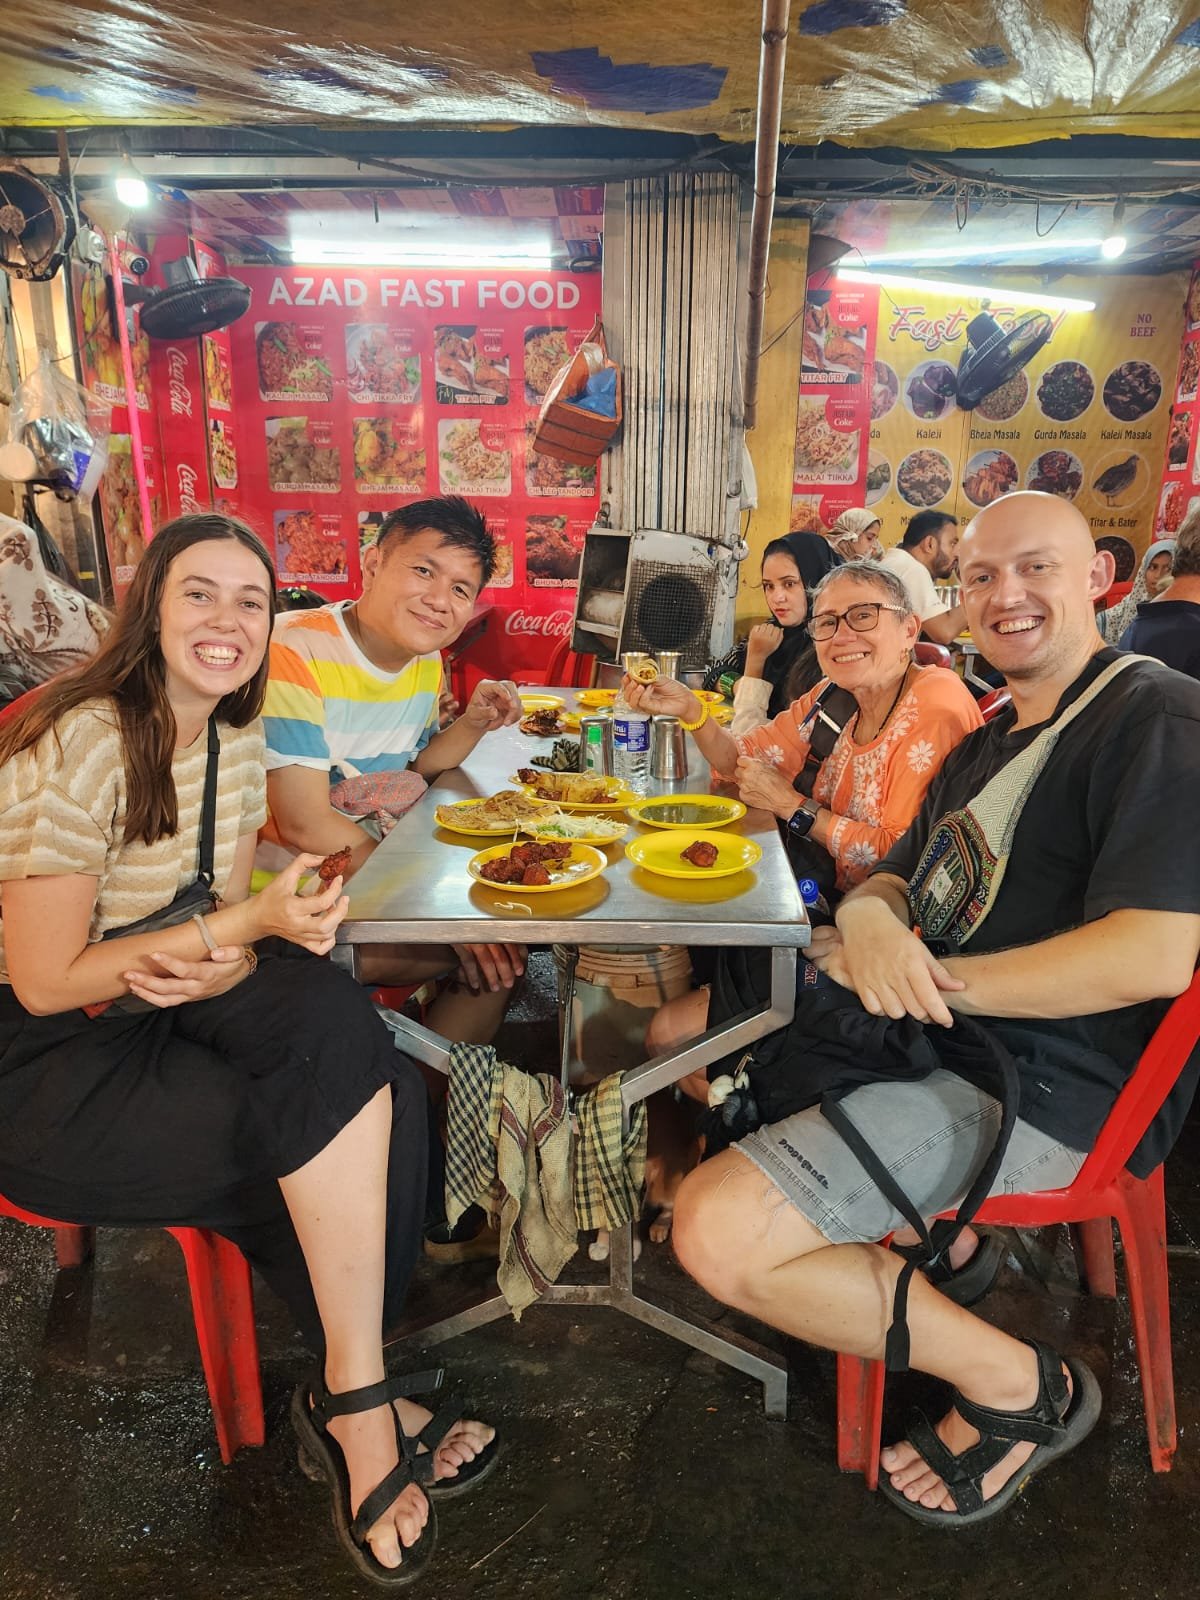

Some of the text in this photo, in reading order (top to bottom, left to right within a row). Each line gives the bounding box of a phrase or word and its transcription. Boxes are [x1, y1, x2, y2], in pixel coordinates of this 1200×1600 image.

[268, 277, 580, 309] AZAD FAST FOOD
[1137, 313, 1152, 324] NO
[889, 306, 968, 350] Fast
[1130, 326, 1157, 337] BEEF
[166, 347, 193, 418] Coca-Cola
[833, 417, 854, 427] Coke
[916, 428, 942, 440] Kaleji
[970, 429, 1020, 440] Bheja Masala
[1034, 429, 1087, 440] Gurda Masala
[1101, 429, 1152, 440] Kaleji Masala
[797, 473, 825, 481] MALAI
[558, 488, 594, 496] TANDOORI
[1090, 517, 1138, 528] Titar & Bater
[505, 609, 574, 637] Coca-Col
[804, 963, 818, 985] ORT
